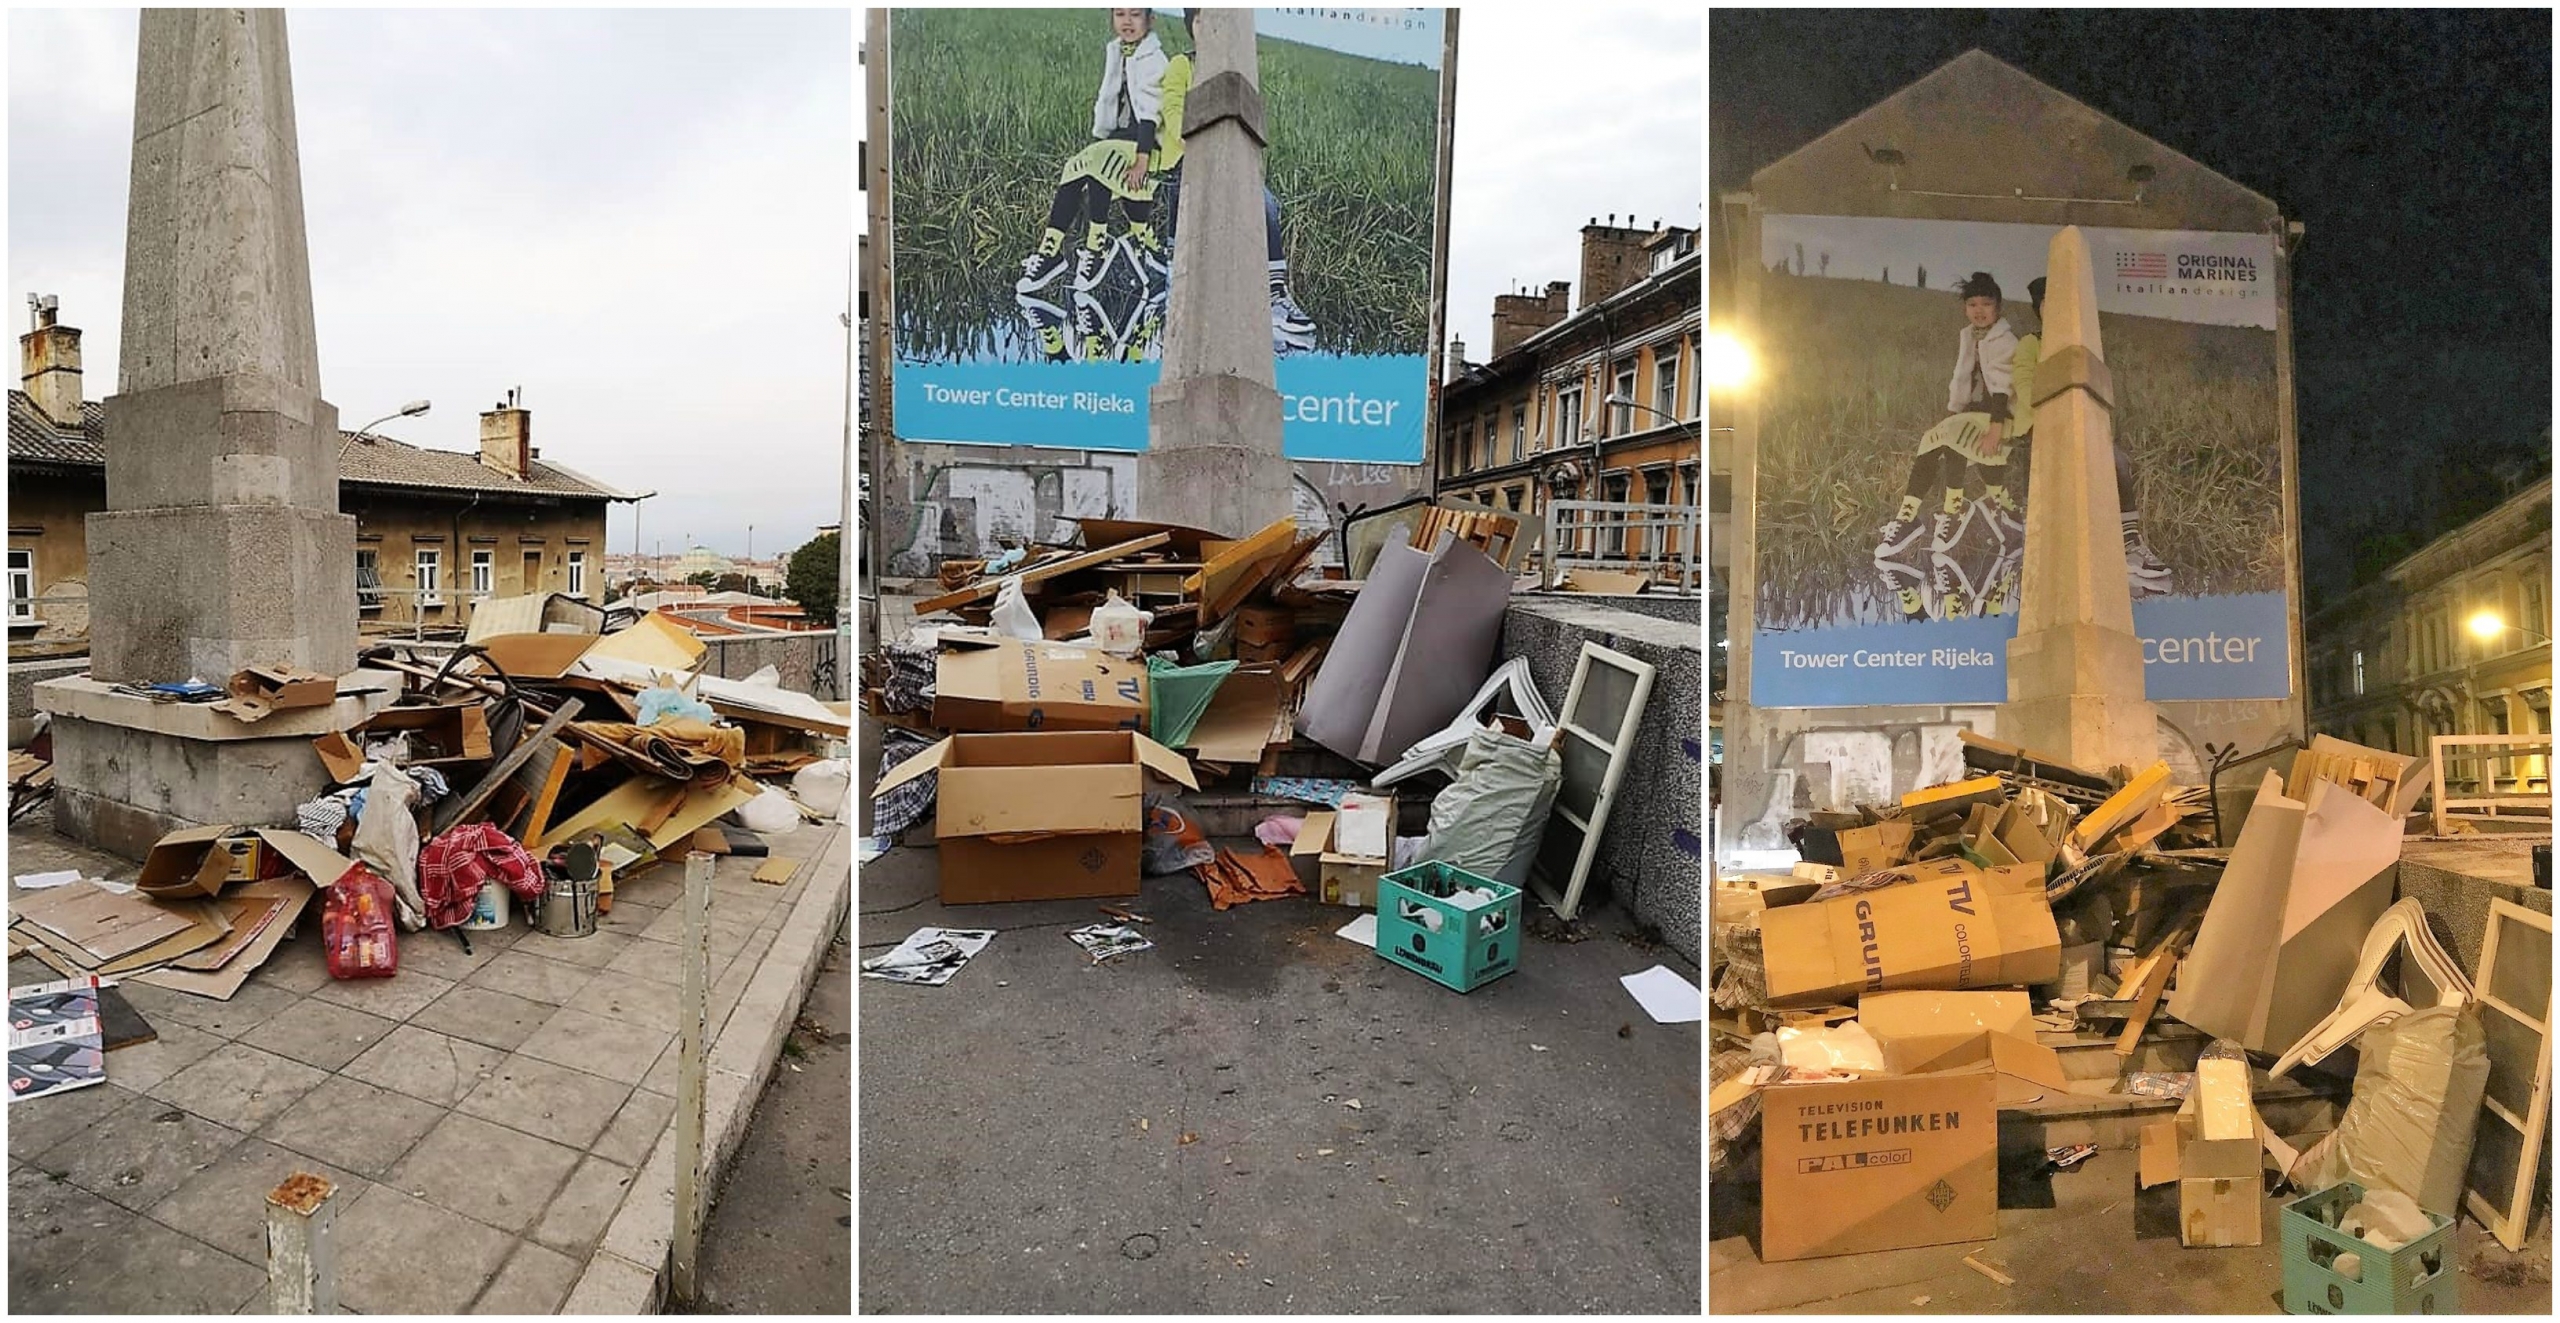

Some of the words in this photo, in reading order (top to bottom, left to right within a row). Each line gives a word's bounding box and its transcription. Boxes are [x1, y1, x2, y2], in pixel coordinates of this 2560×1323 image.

[2177, 254, 2256, 269] ORIGINAL
[2178, 268, 2258, 282] MARINES
[923, 384, 991, 405] Tower
[995, 388, 1068, 409] Center
[1073, 392, 1135, 415] Rijeka
[1283, 392, 1400, 426] center
[1780, 650, 1848, 668] Tower
[1853, 649, 1927, 667] Center
[1931, 648, 1994, 670] Rijeka
[2142, 631, 2262, 664] center
[1024, 649, 1041, 699] GRUNDIG
[1116, 677, 1142, 703] TV
[1946, 880, 1976, 916] TV
[1954, 923, 1972, 963] COLOR
[1798, 1100, 1883, 1117] TELEVISION
[1798, 1111, 1960, 1143] TELEFUNKEN
[1869, 1150, 1910, 1165] color
